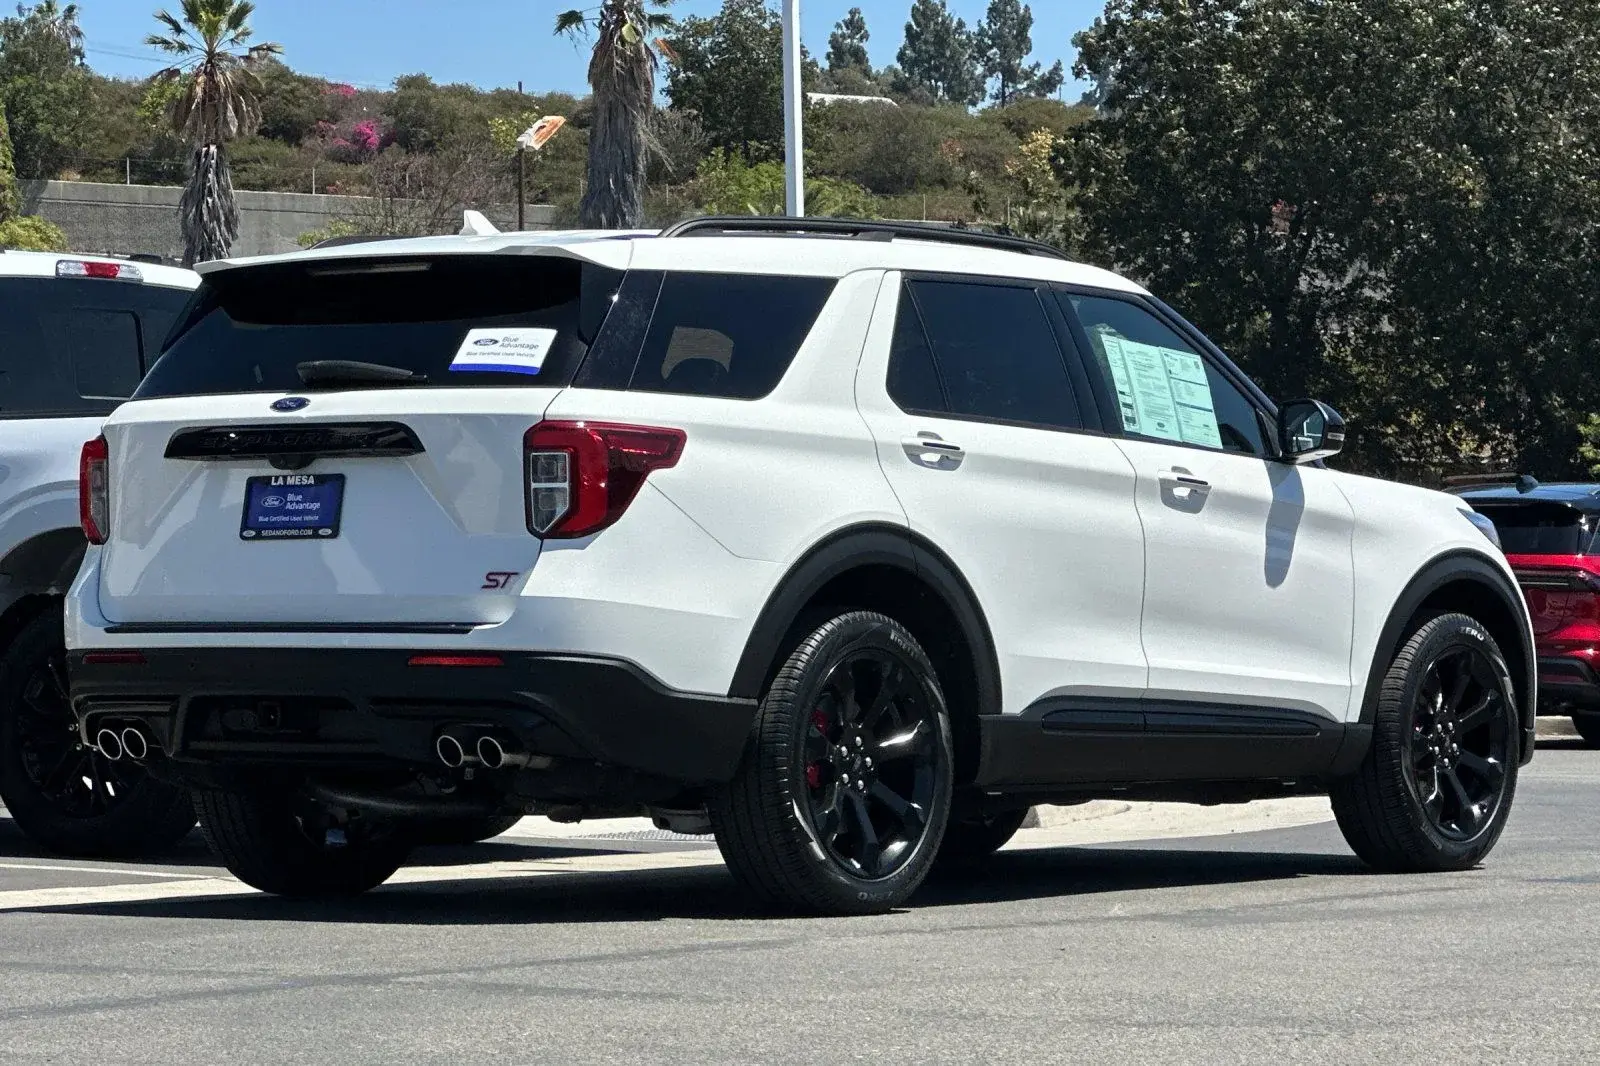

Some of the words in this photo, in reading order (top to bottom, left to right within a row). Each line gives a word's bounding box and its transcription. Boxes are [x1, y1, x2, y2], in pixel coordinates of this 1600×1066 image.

[499, 342, 539, 350] Advantage
[271, 476, 284, 486] LA
[286, 475, 315, 485] MESA
[263, 497, 283, 506] Ford
[286, 493, 303, 501] Blue
[285, 502, 320, 511] Advantage
[261, 529, 313, 537] SEDANOFORD.COM
[481, 571, 519, 589] ST
